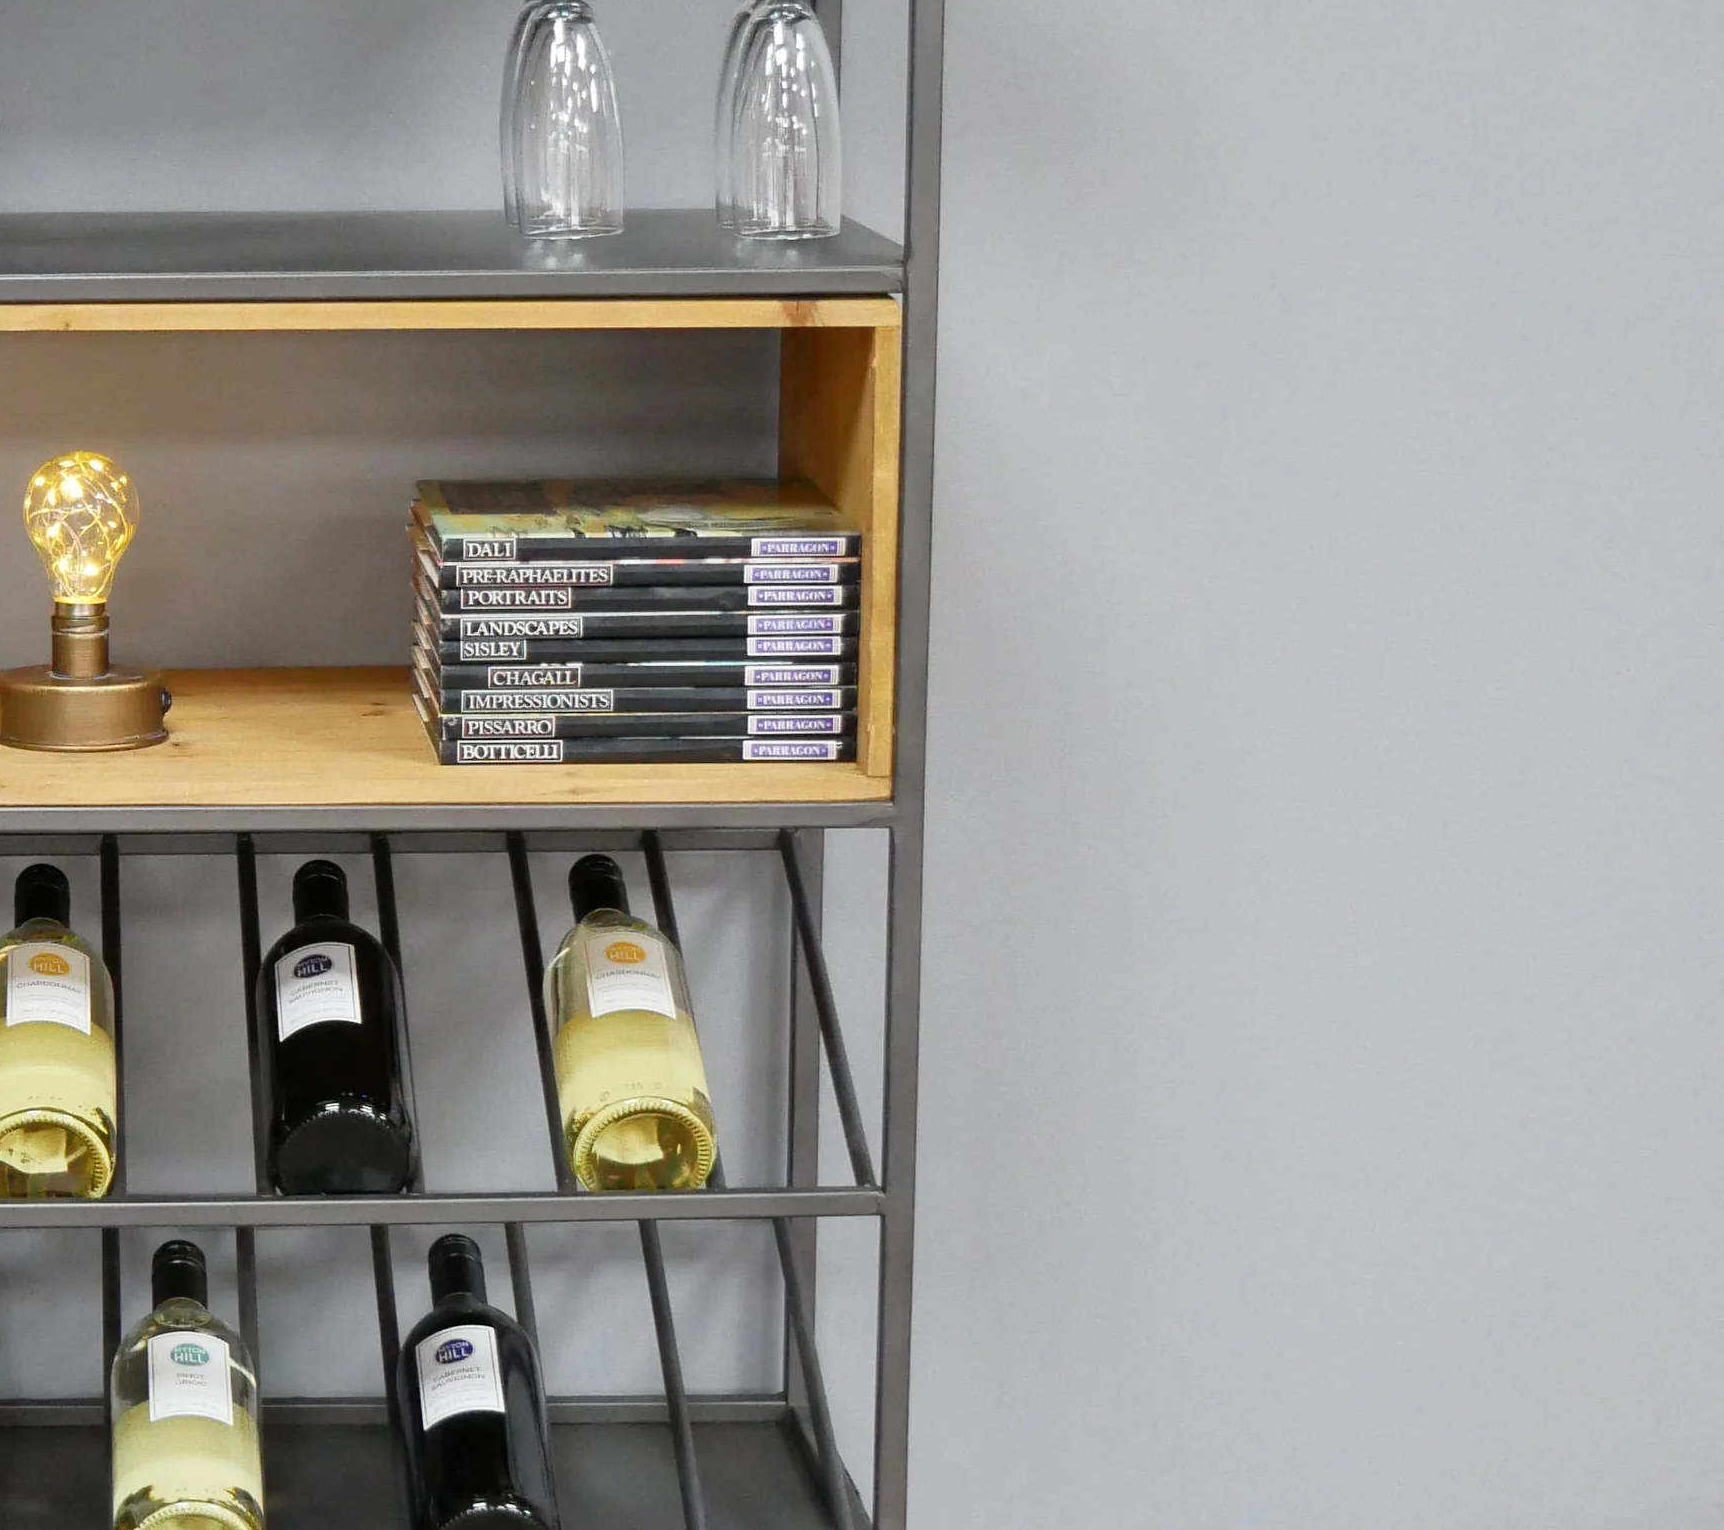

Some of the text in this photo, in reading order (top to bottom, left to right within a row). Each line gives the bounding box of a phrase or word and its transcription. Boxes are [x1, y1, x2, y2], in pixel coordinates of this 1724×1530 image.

[466, 542, 512, 558] DALI
[767, 543, 830, 554] PARRAGON
[461, 568, 609, 584] PRE-RAPHAELITES
[759, 568, 822, 579] PARRAGON
[466, 590, 568, 606] PORTRAITS
[763, 590, 826, 601] PARRAGON
[465, 620, 579, 637] LANDSCAPES
[763, 619, 826, 630] PARRAGON
[464, 641, 521, 657] SISLEY
[762, 640, 825, 651] PARRAGON
[493, 671, 576, 686] CHAGALL
[760, 670, 824, 681] PARRAGON
[468, 693, 610, 710] IMPRESSIONISTS
[762, 694, 825, 705] PARRAGON
[467, 720, 552, 736] PISSARRO
[763, 720, 826, 731] PARRAGON
[461, 744, 559, 760] BOTTICELLI
[758, 745, 821, 756] PARRAGON
[610, 950, 642, 961] HILL
[34, 961, 65, 974] HILL
[297, 962, 329, 977] HILL
[174, 1352, 207, 1365] HILL
[438, 1348, 470, 1364] HILL
